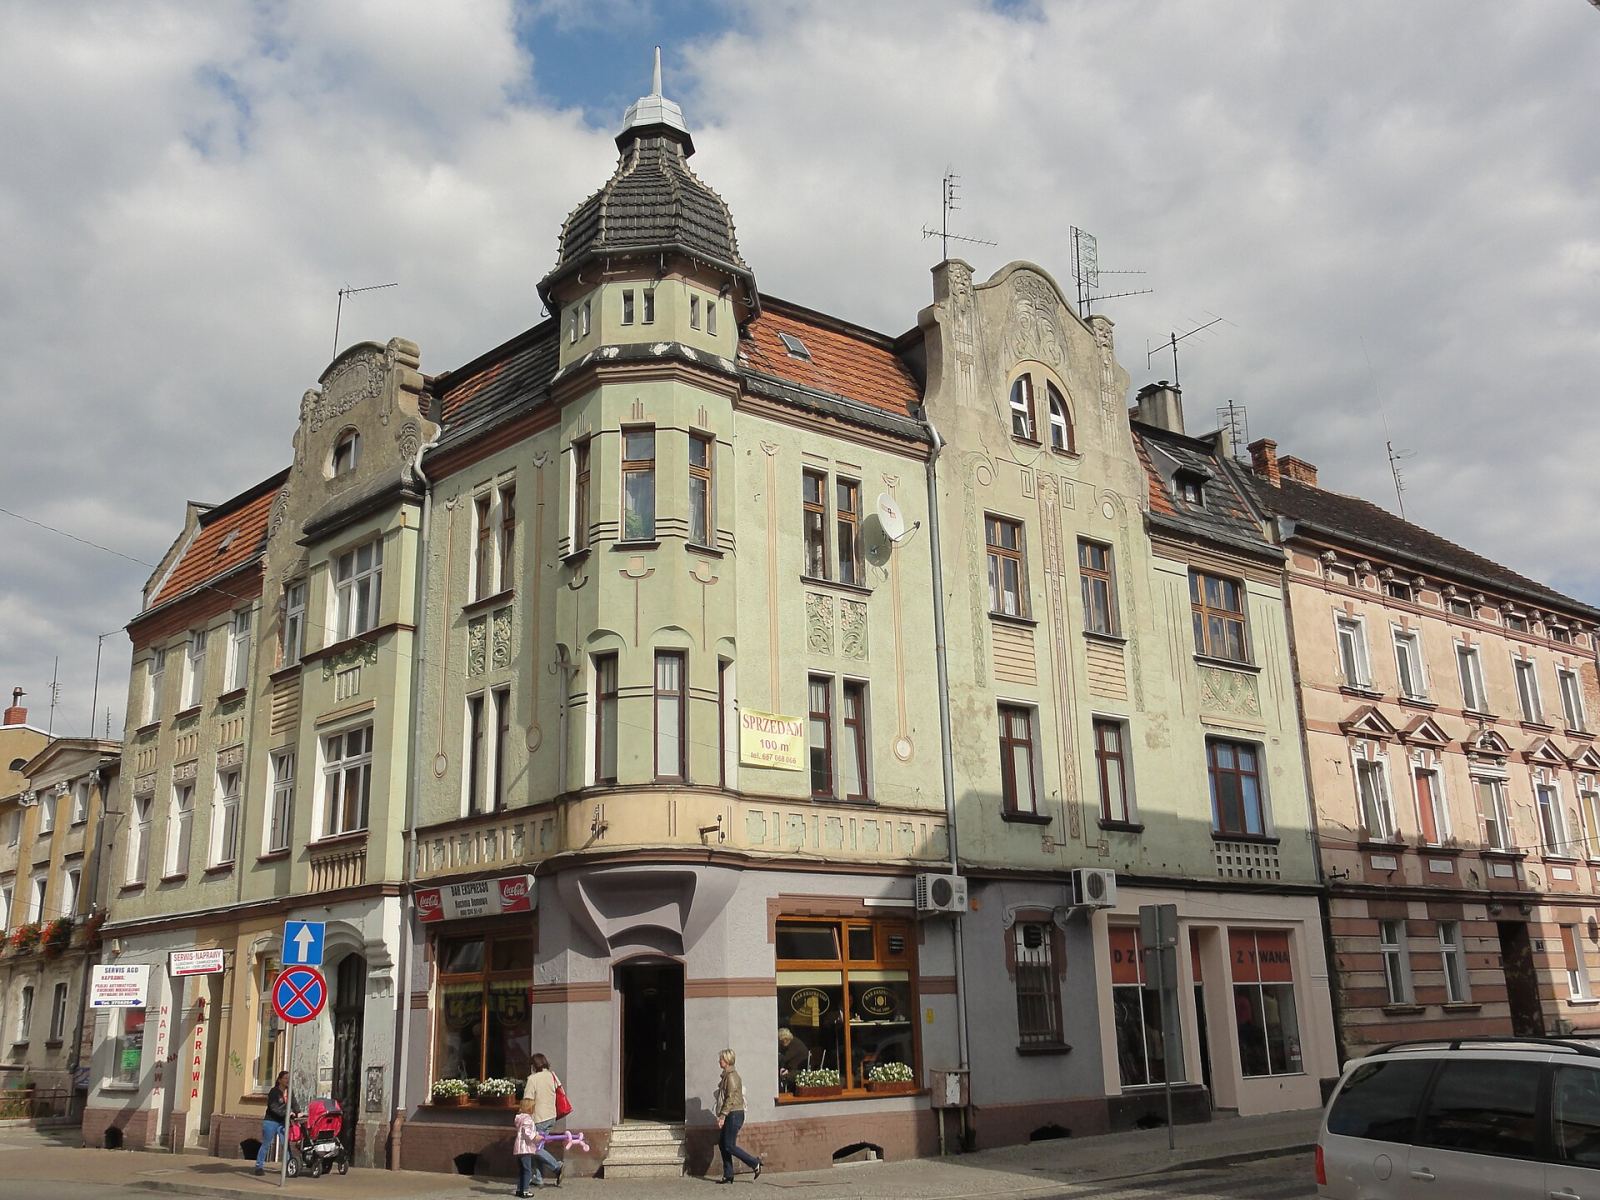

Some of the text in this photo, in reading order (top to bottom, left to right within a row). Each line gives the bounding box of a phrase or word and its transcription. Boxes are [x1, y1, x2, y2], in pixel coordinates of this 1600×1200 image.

[743, 714, 803, 737] SPRZEDAM
[760, 739, 778, 751] 100
[451, 882, 489, 896] BAR EKSPRESSO
[153, 1006, 168, 1095] NAPRAWA
[191, 997, 205, 1098] NAPRAWA
